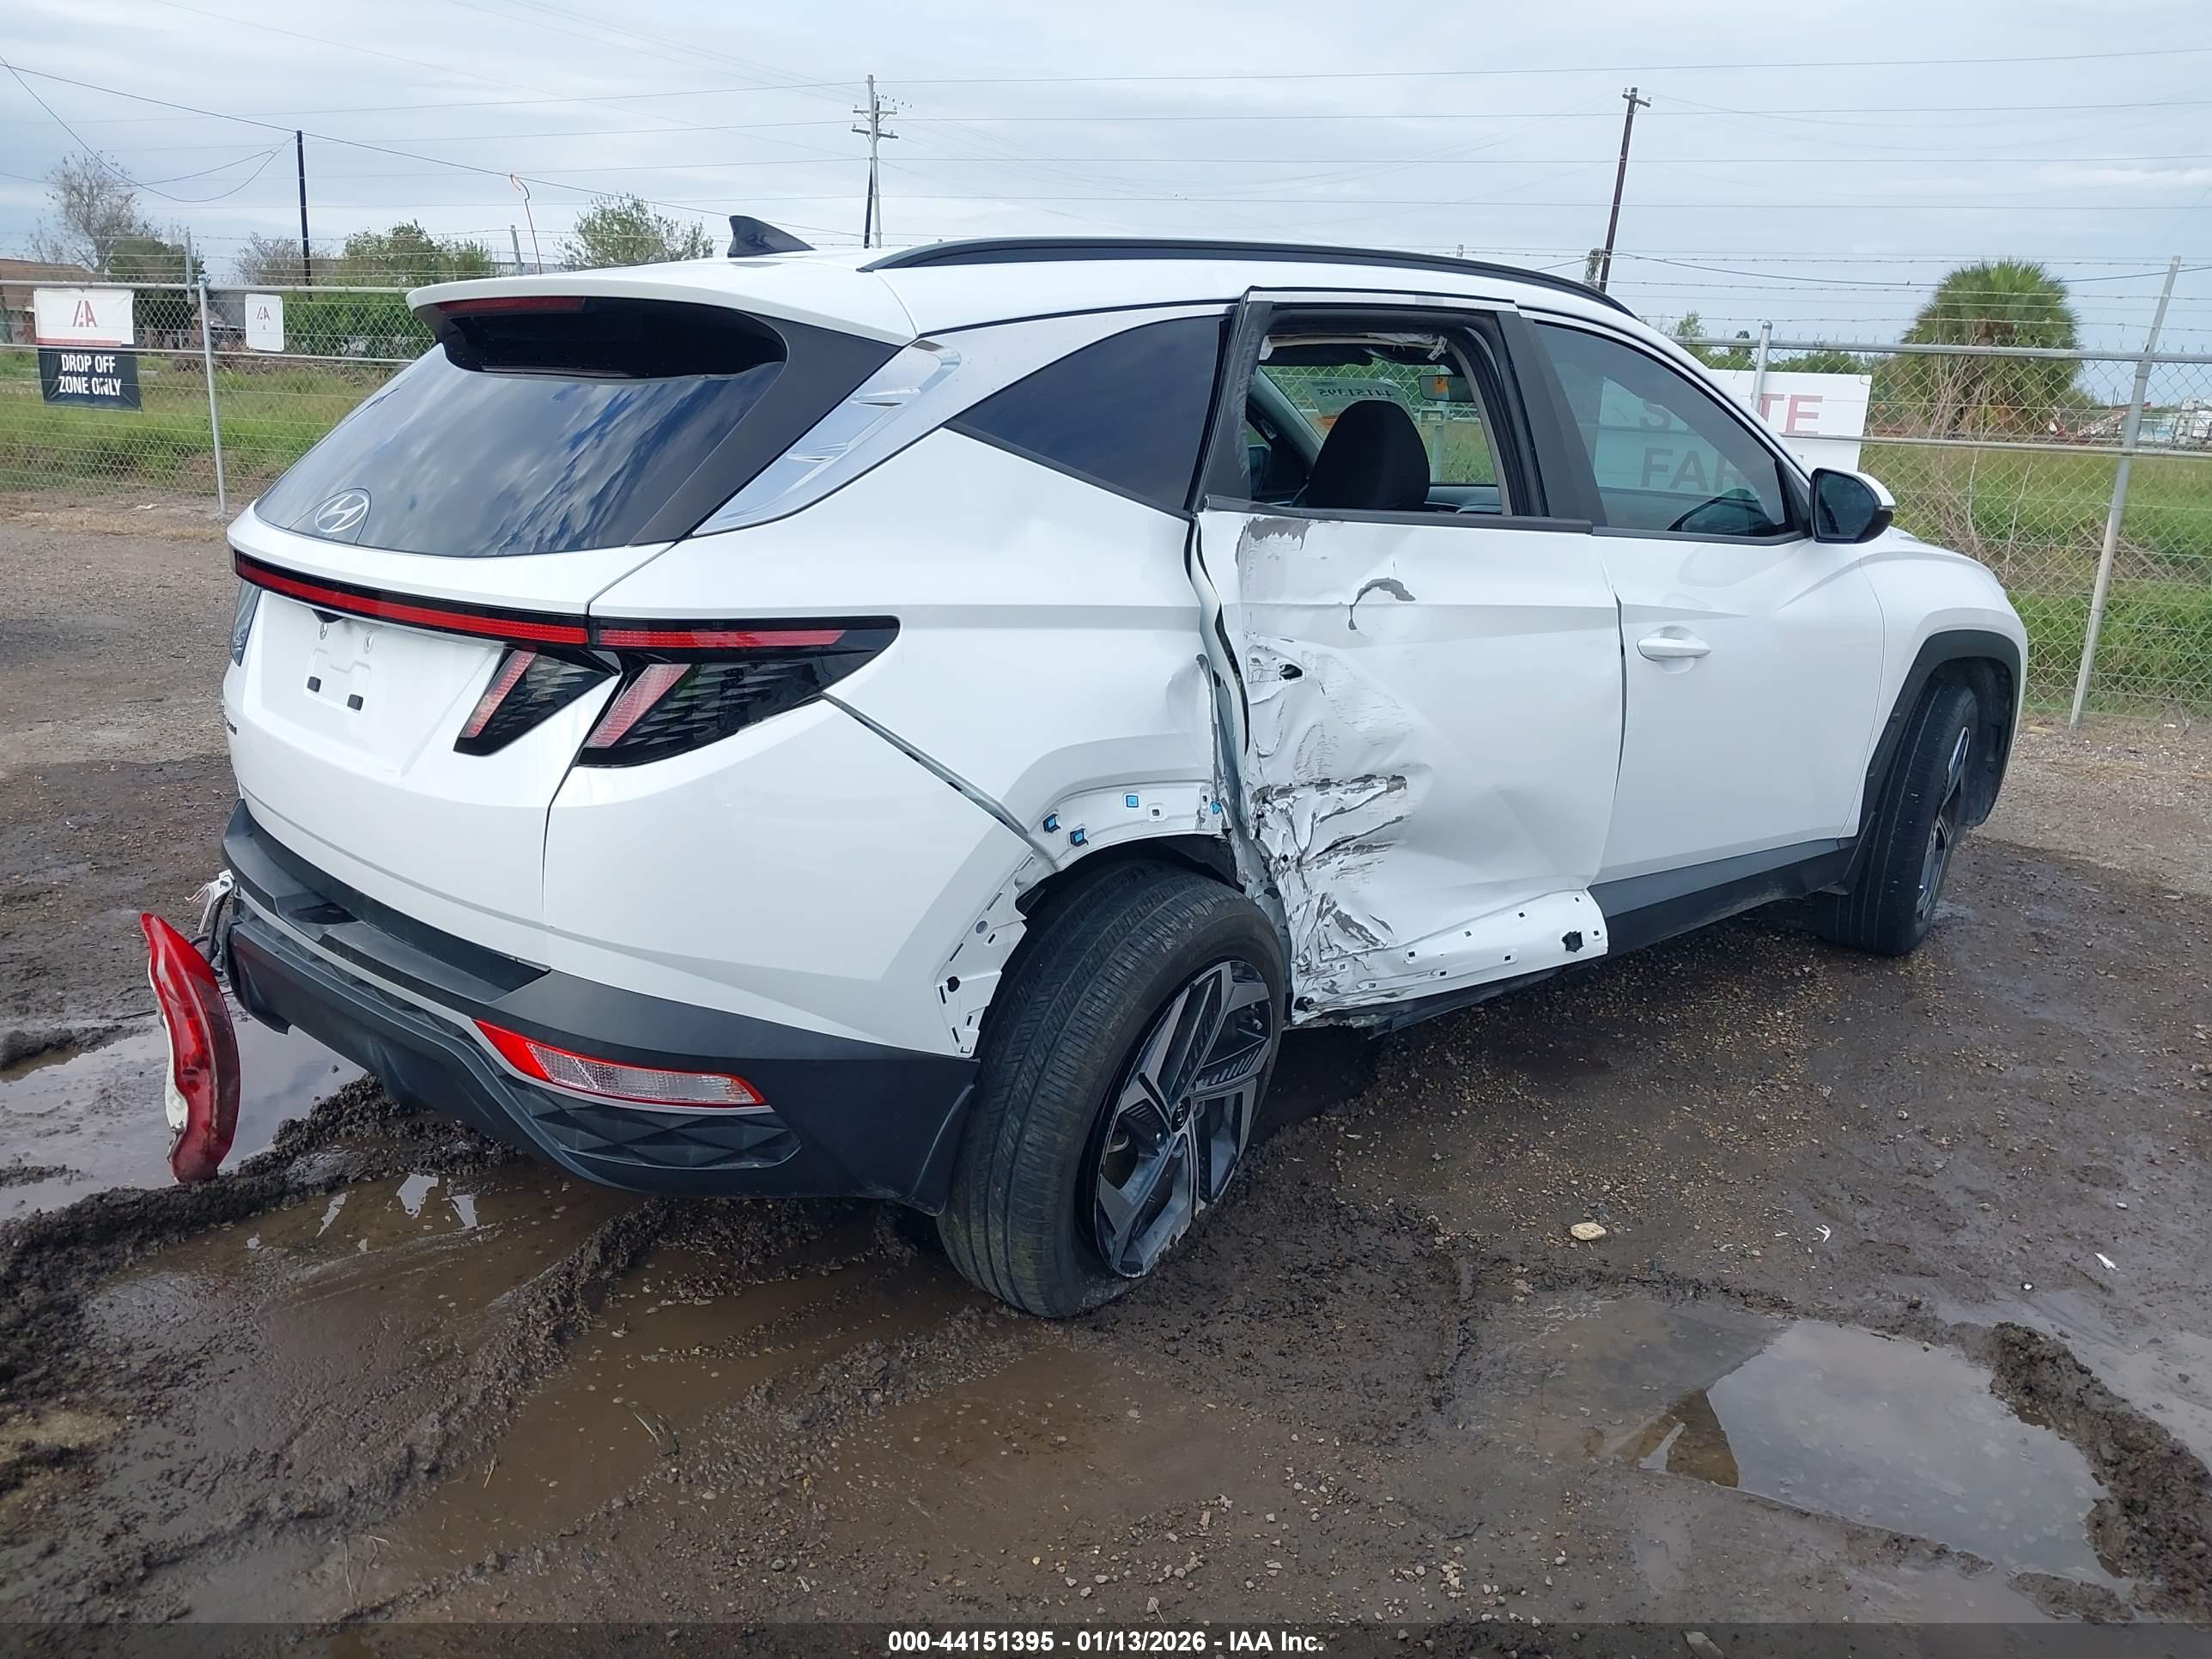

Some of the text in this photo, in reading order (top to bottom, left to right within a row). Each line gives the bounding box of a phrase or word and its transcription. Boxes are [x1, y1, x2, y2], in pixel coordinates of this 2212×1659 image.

[61, 354, 116, 374] DROP OFF
[58, 375, 121, 396] ZONE ONLY
